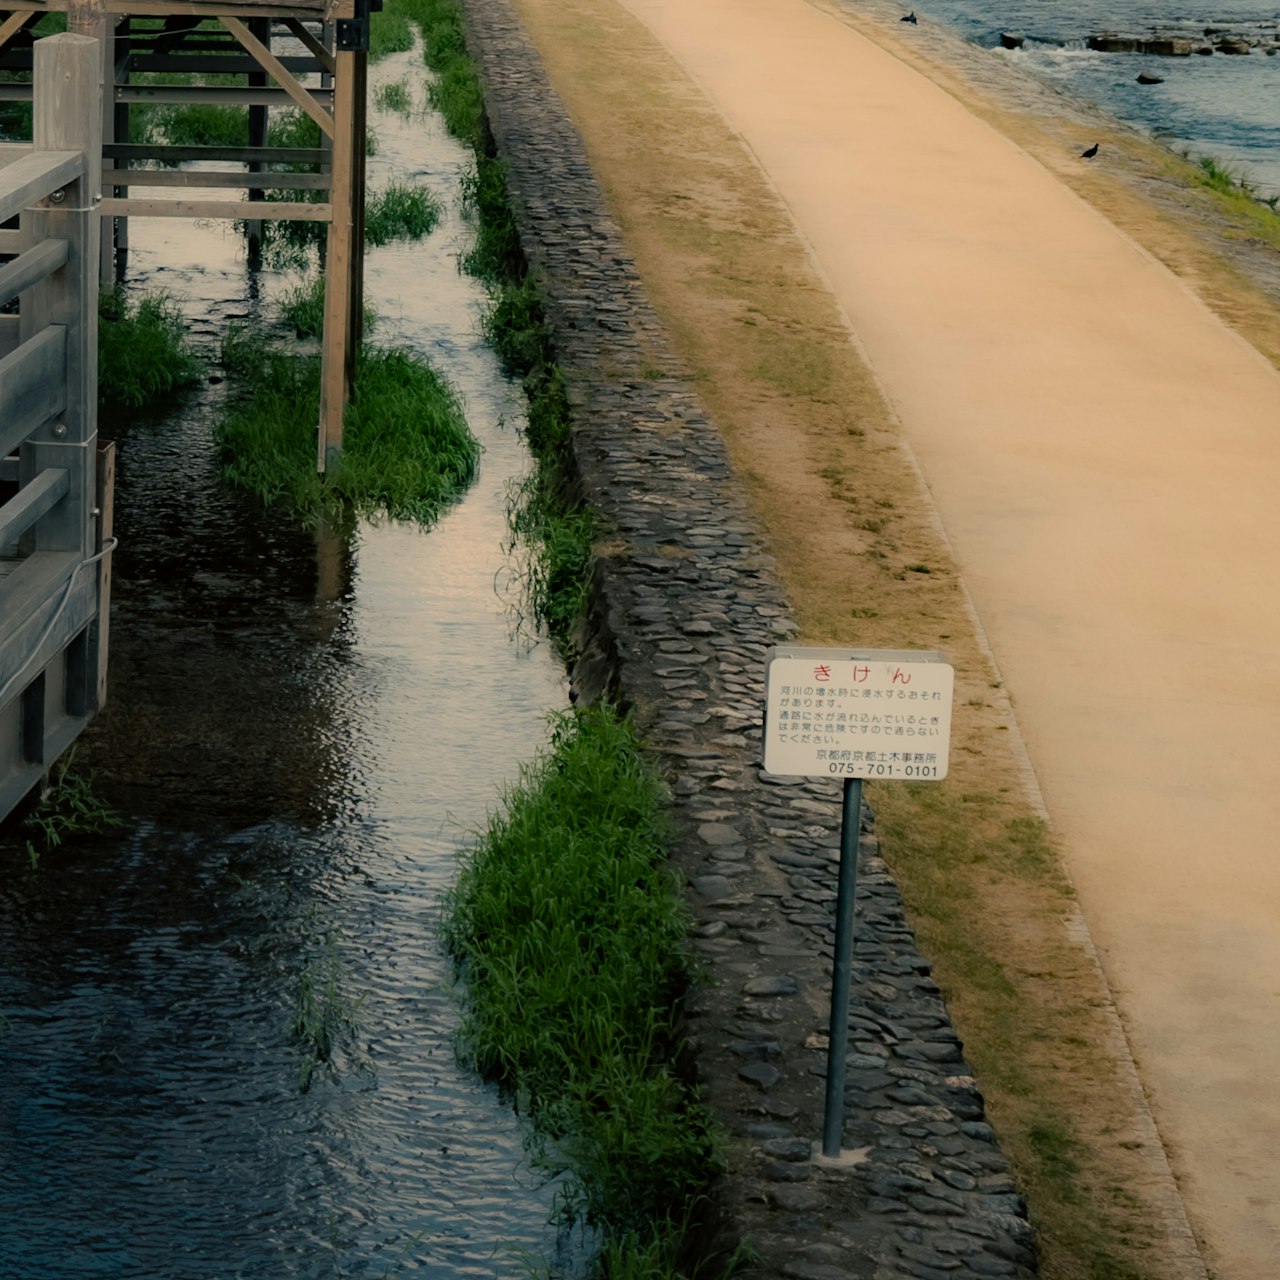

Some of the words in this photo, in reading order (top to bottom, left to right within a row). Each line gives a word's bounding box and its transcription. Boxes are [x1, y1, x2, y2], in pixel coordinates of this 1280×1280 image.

[813, 664, 912, 685] きけん
[780, 698, 843, 709] があります。
[778, 734, 841, 745] でください。
[816, 749, 937, 764] 京都府京都土木事務所
[829, 762, 938, 777] 075-701-0101
